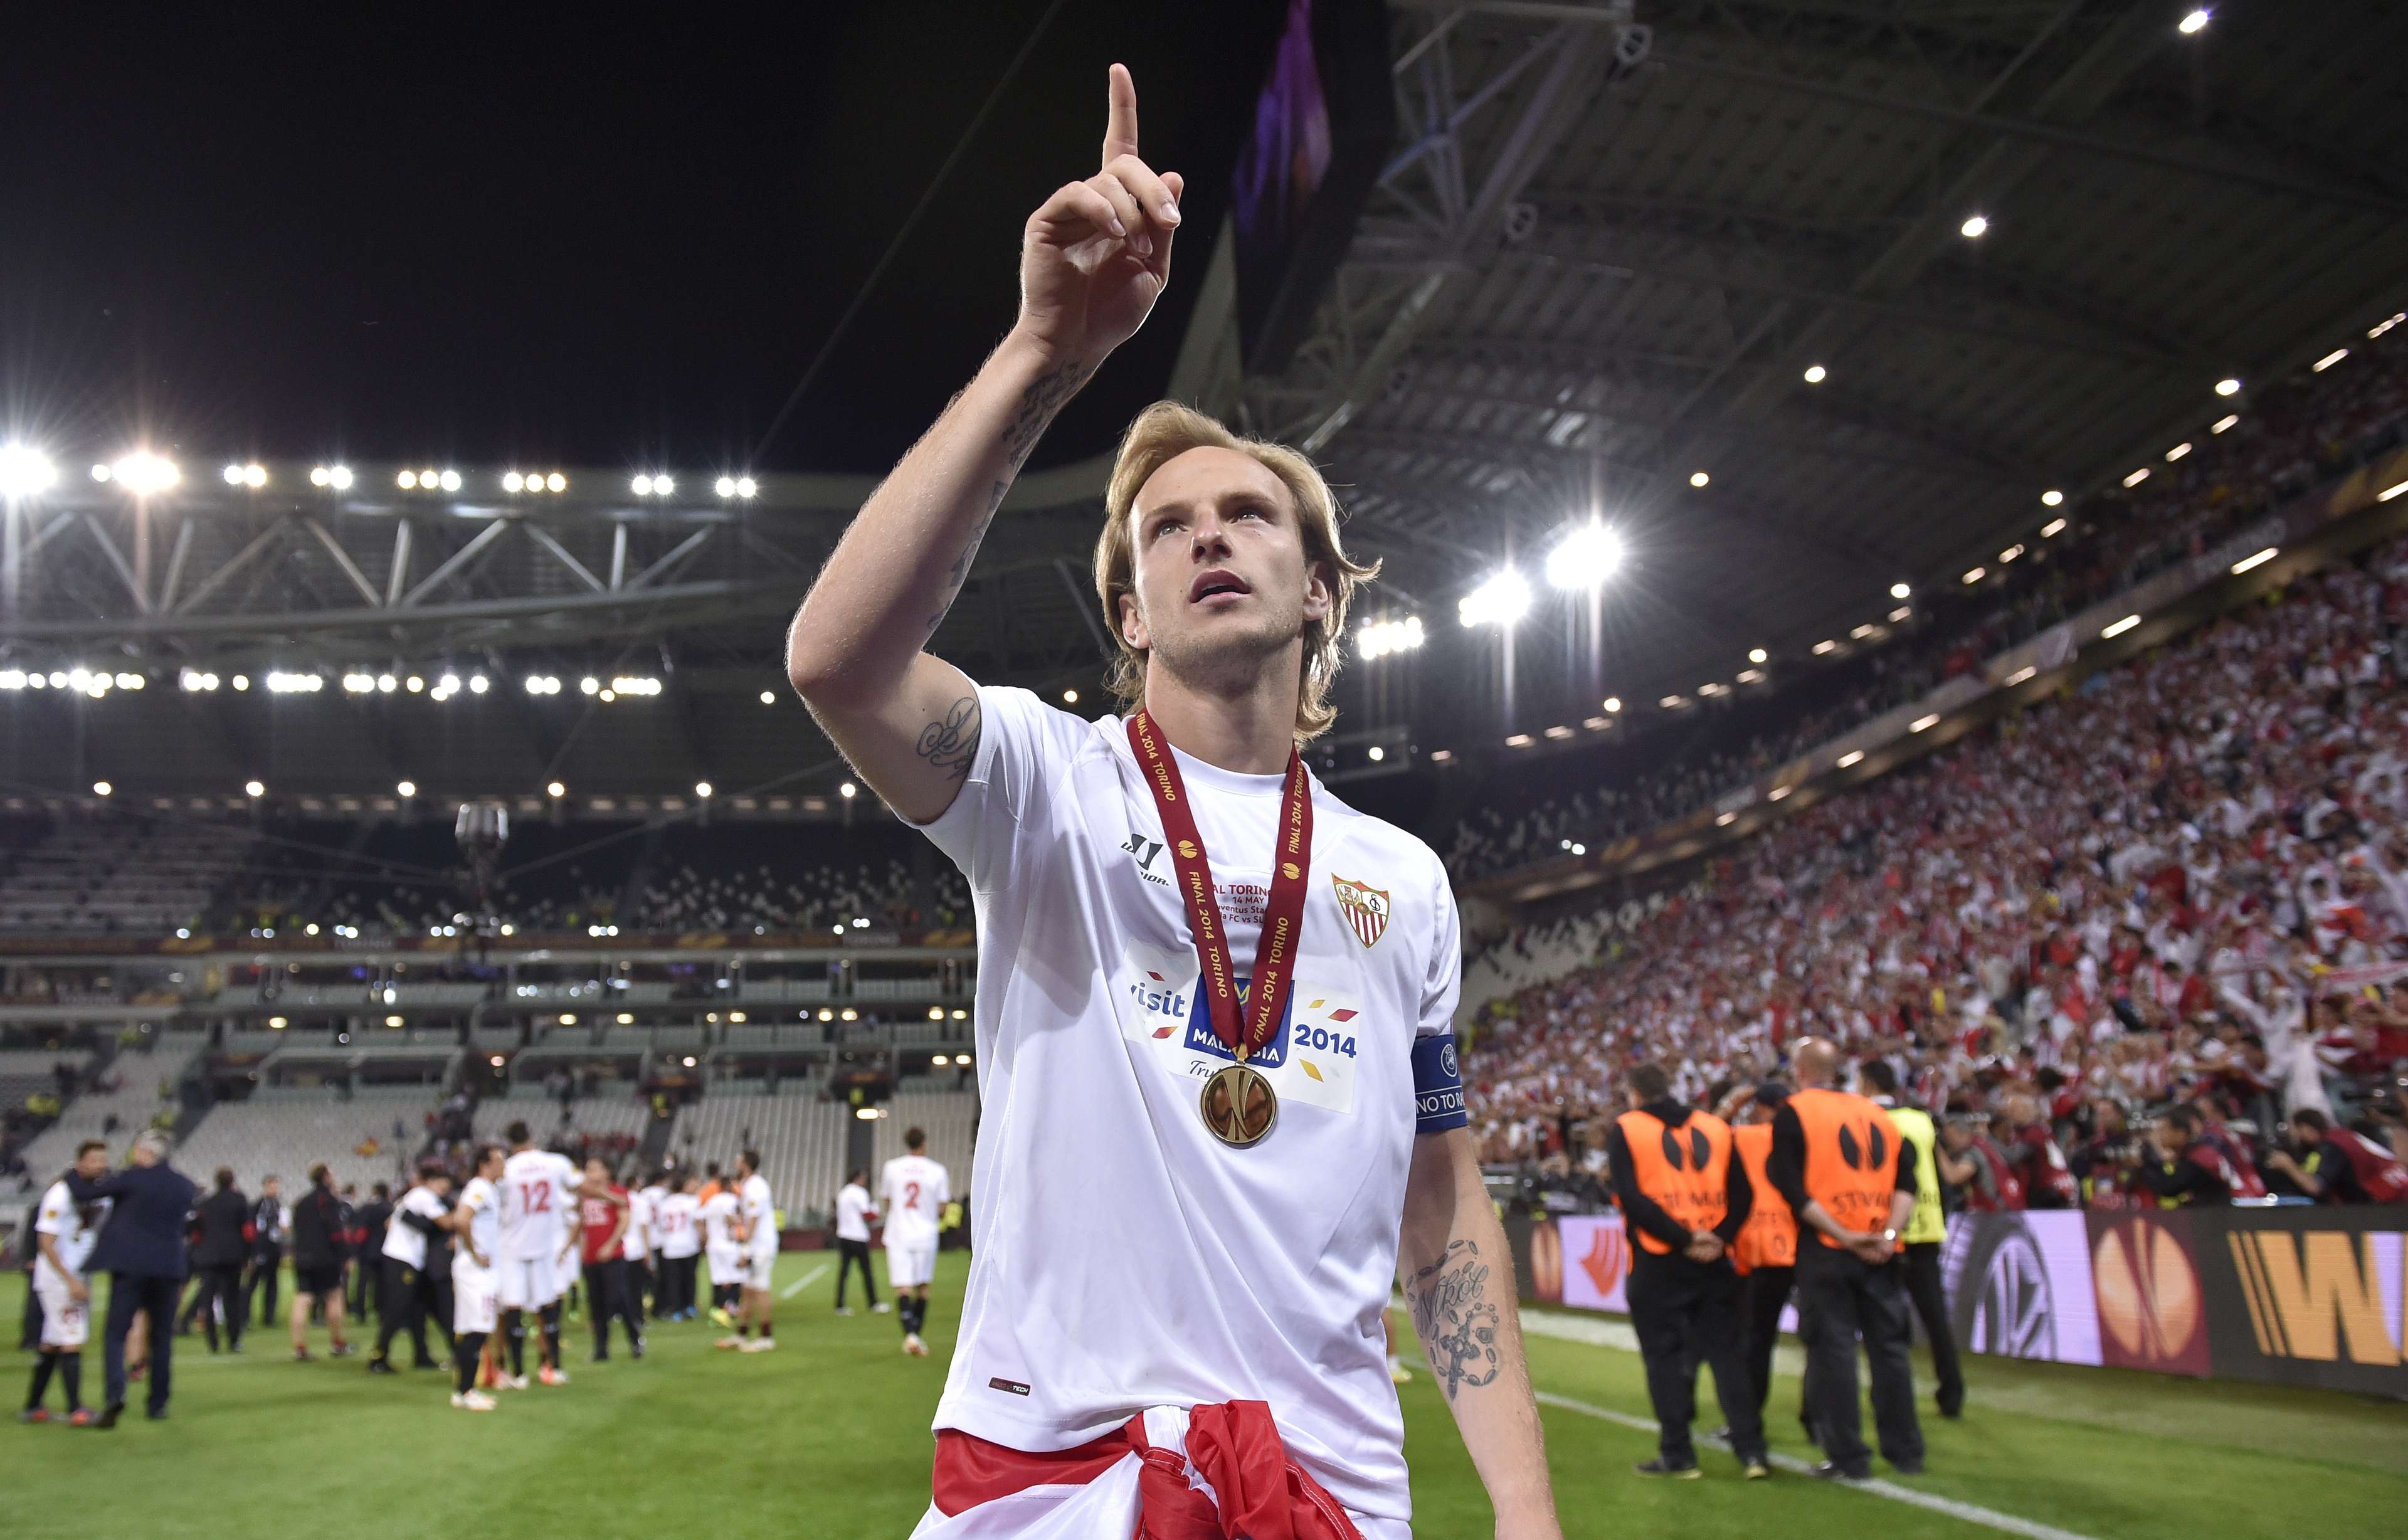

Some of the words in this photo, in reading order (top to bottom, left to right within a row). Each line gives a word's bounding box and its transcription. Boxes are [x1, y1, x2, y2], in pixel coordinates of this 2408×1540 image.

[1136, 712, 1149, 736] FINAL
[1141, 736, 1159, 759] 2014
[1153, 761, 1176, 801] TORINO
[1292, 801, 1303, 826] 2014
[1288, 828, 1301, 854] FINAL
[1228, 885, 1271, 897] TORIN
[1229, 914, 1240, 922] FC
[1189, 871, 1206, 905] FINAL
[1199, 909, 1215, 940] 2014
[1208, 946, 1228, 998] TORINO
[1269, 917, 1289, 964] TORINO
[1262, 970, 1278, 1003] 2014
[1254, 1006, 1270, 1043] FINAL
[1294, 1024, 1357, 1059] 2014
[1190, 1060, 1222, 1078] Tru
[1415, 1096, 1439, 1114] NO
[1440, 1094, 1455, 1110] TO
[519, 1179, 552, 1215] 12
[905, 1181, 921, 1210] 2
[1012, 1385, 1029, 1393] TECH
